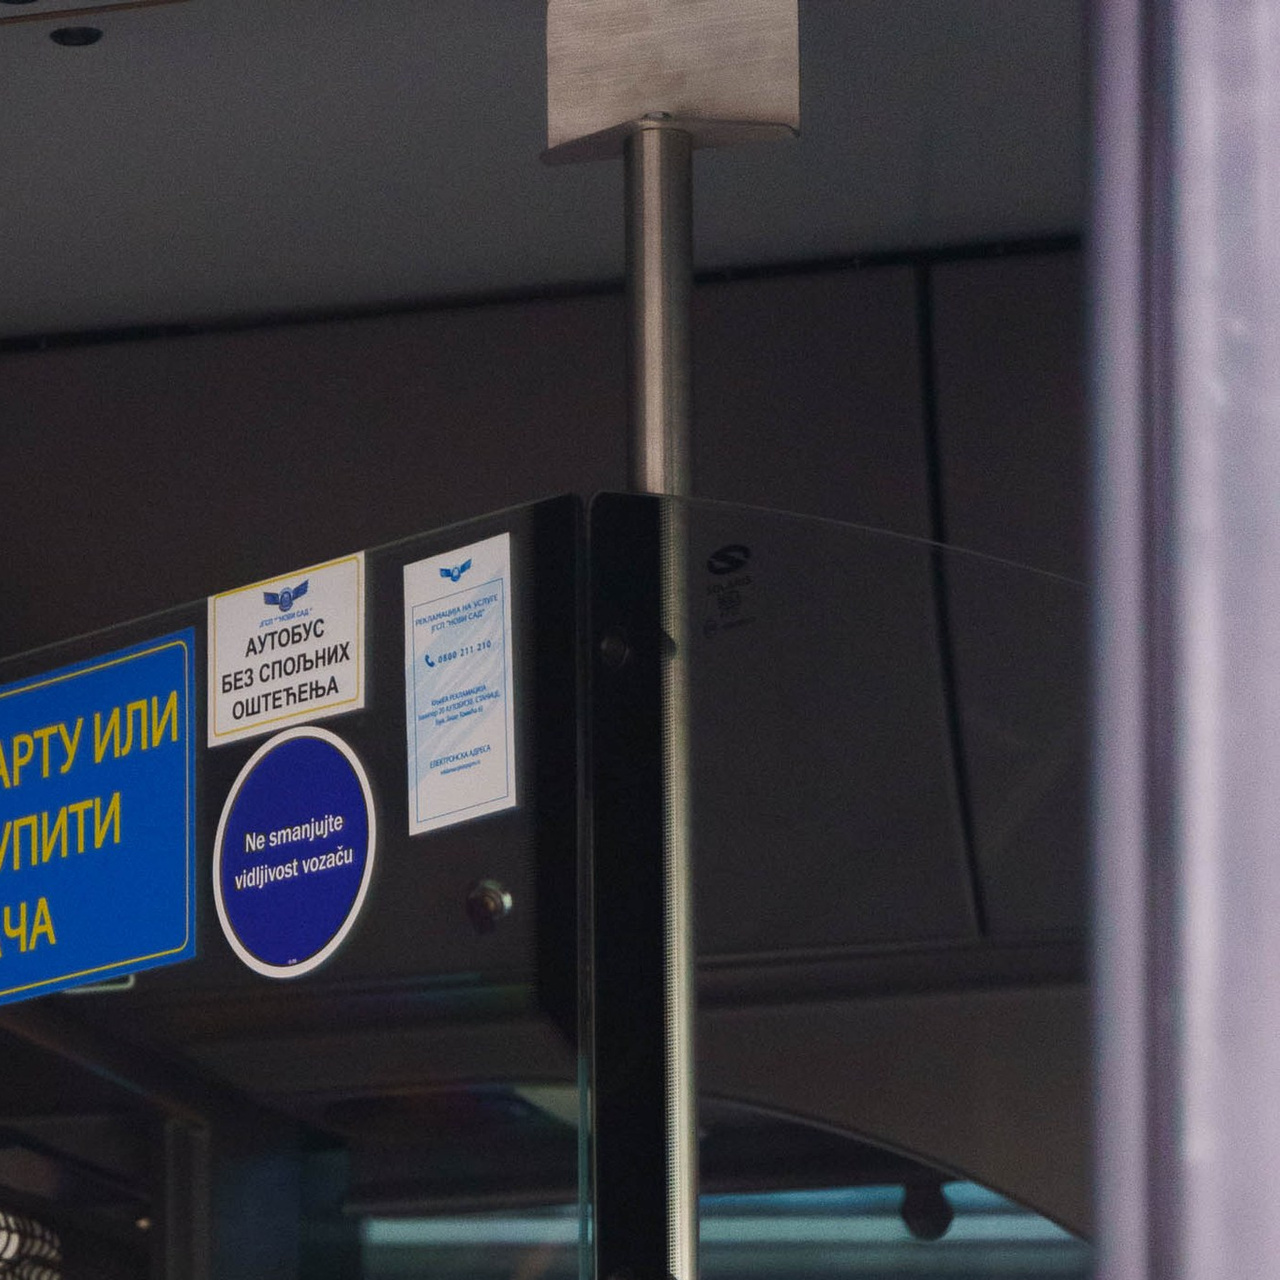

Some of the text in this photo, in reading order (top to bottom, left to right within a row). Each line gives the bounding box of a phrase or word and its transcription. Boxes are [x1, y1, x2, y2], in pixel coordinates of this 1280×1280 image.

[245, 618, 325, 658] АУТОБУС
[460, 645, 474, 657] 211
[477, 640, 492, 652] 210
[222, 641, 350, 694] БЕЗ СПОЉНИХ
[232, 675, 339, 720] ОШТЕЋЕЊА
[93, 690, 179, 764] ИЛИ
[245, 814, 344, 852] Ne smanjujte
[235, 845, 353, 889] vidljivost vozaču
